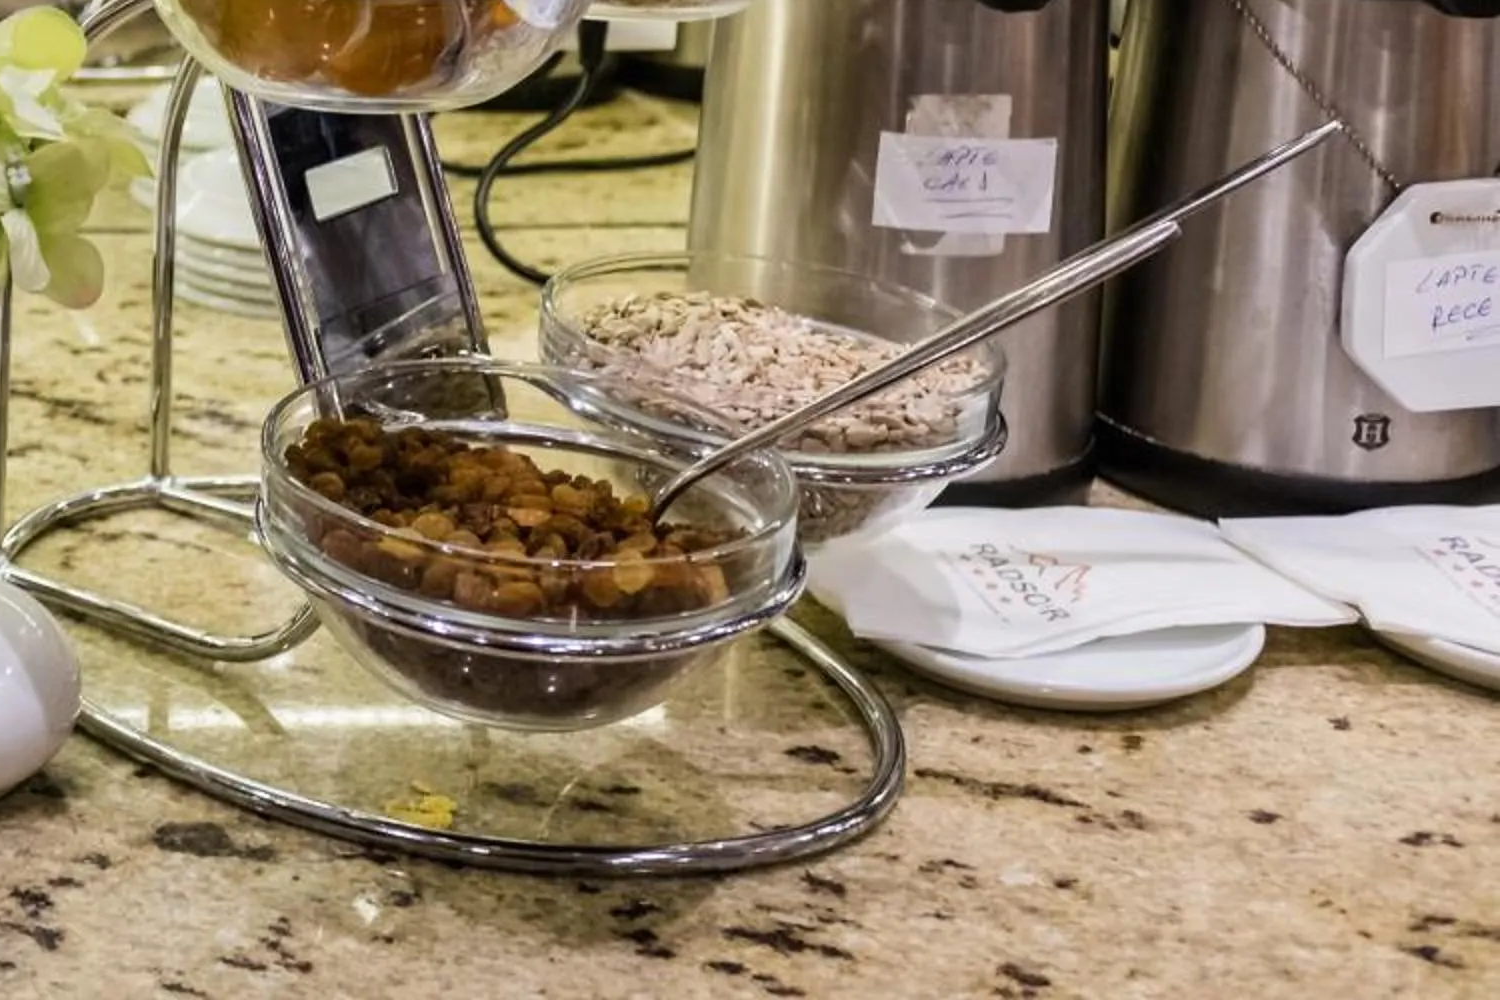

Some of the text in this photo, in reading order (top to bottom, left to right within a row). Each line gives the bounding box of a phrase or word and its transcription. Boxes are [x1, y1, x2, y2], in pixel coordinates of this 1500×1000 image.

[1414, 263, 1498, 294] LAPTE
[1431, 297, 1492, 332] RECE
[969, 543, 1071, 622] RADSOR
[1438, 535, 1500, 590] RAD
